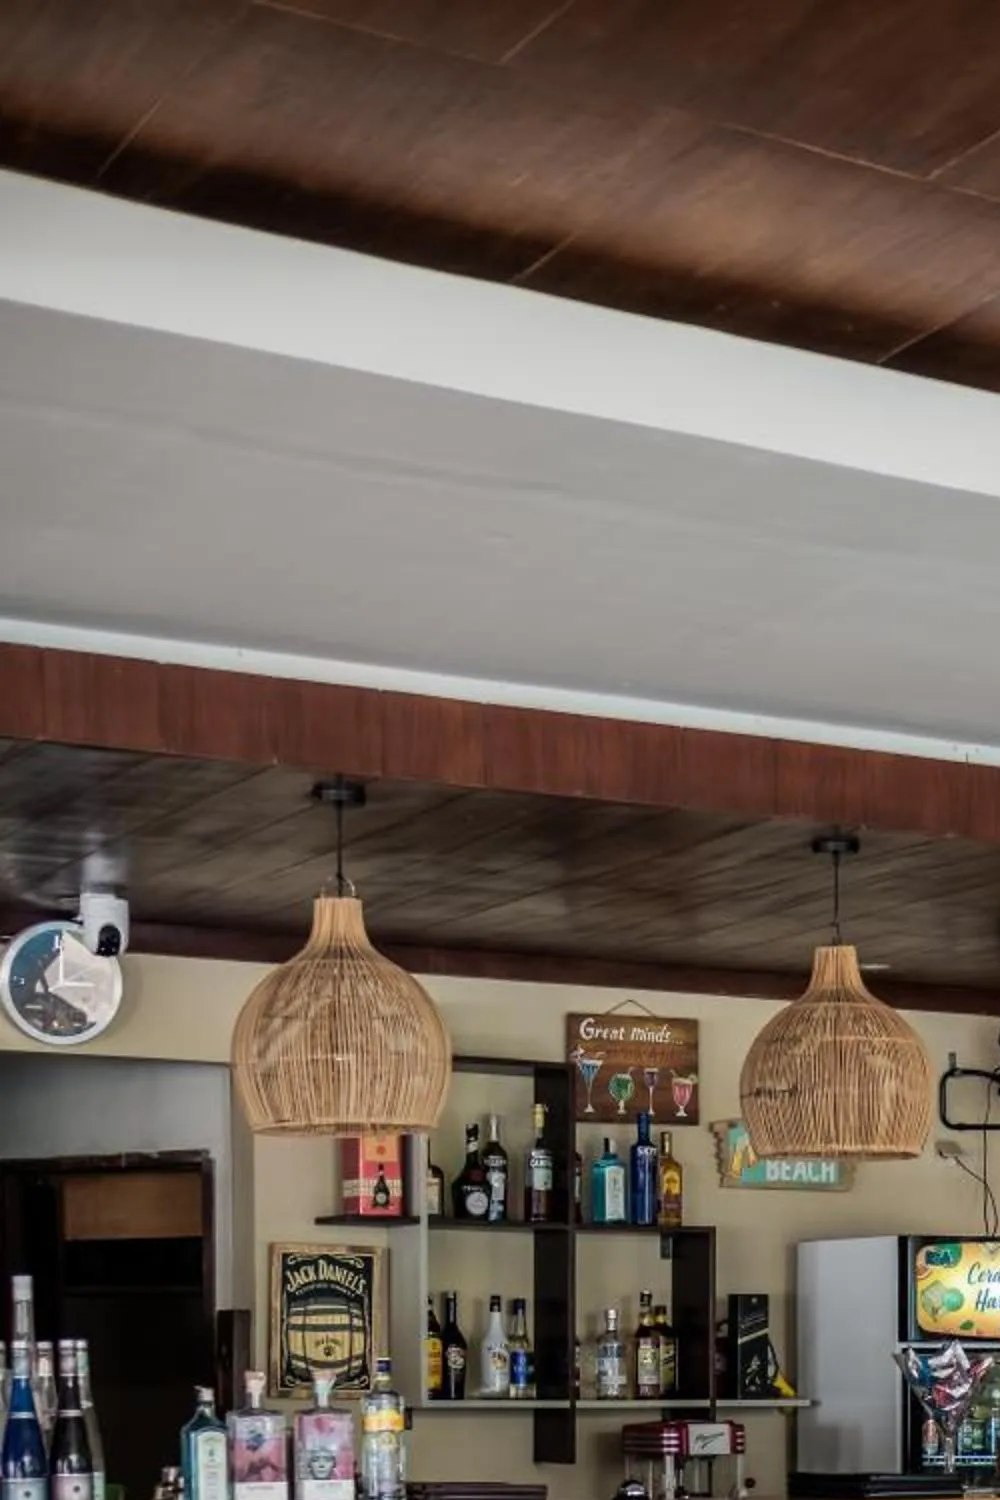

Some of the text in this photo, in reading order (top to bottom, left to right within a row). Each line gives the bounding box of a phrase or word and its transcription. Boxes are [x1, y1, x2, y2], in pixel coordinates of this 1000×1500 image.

[579, 1017, 626, 1041] Great
[765, 1159, 836, 1183] BEACH
[287, 1264, 316, 1293] JACK
